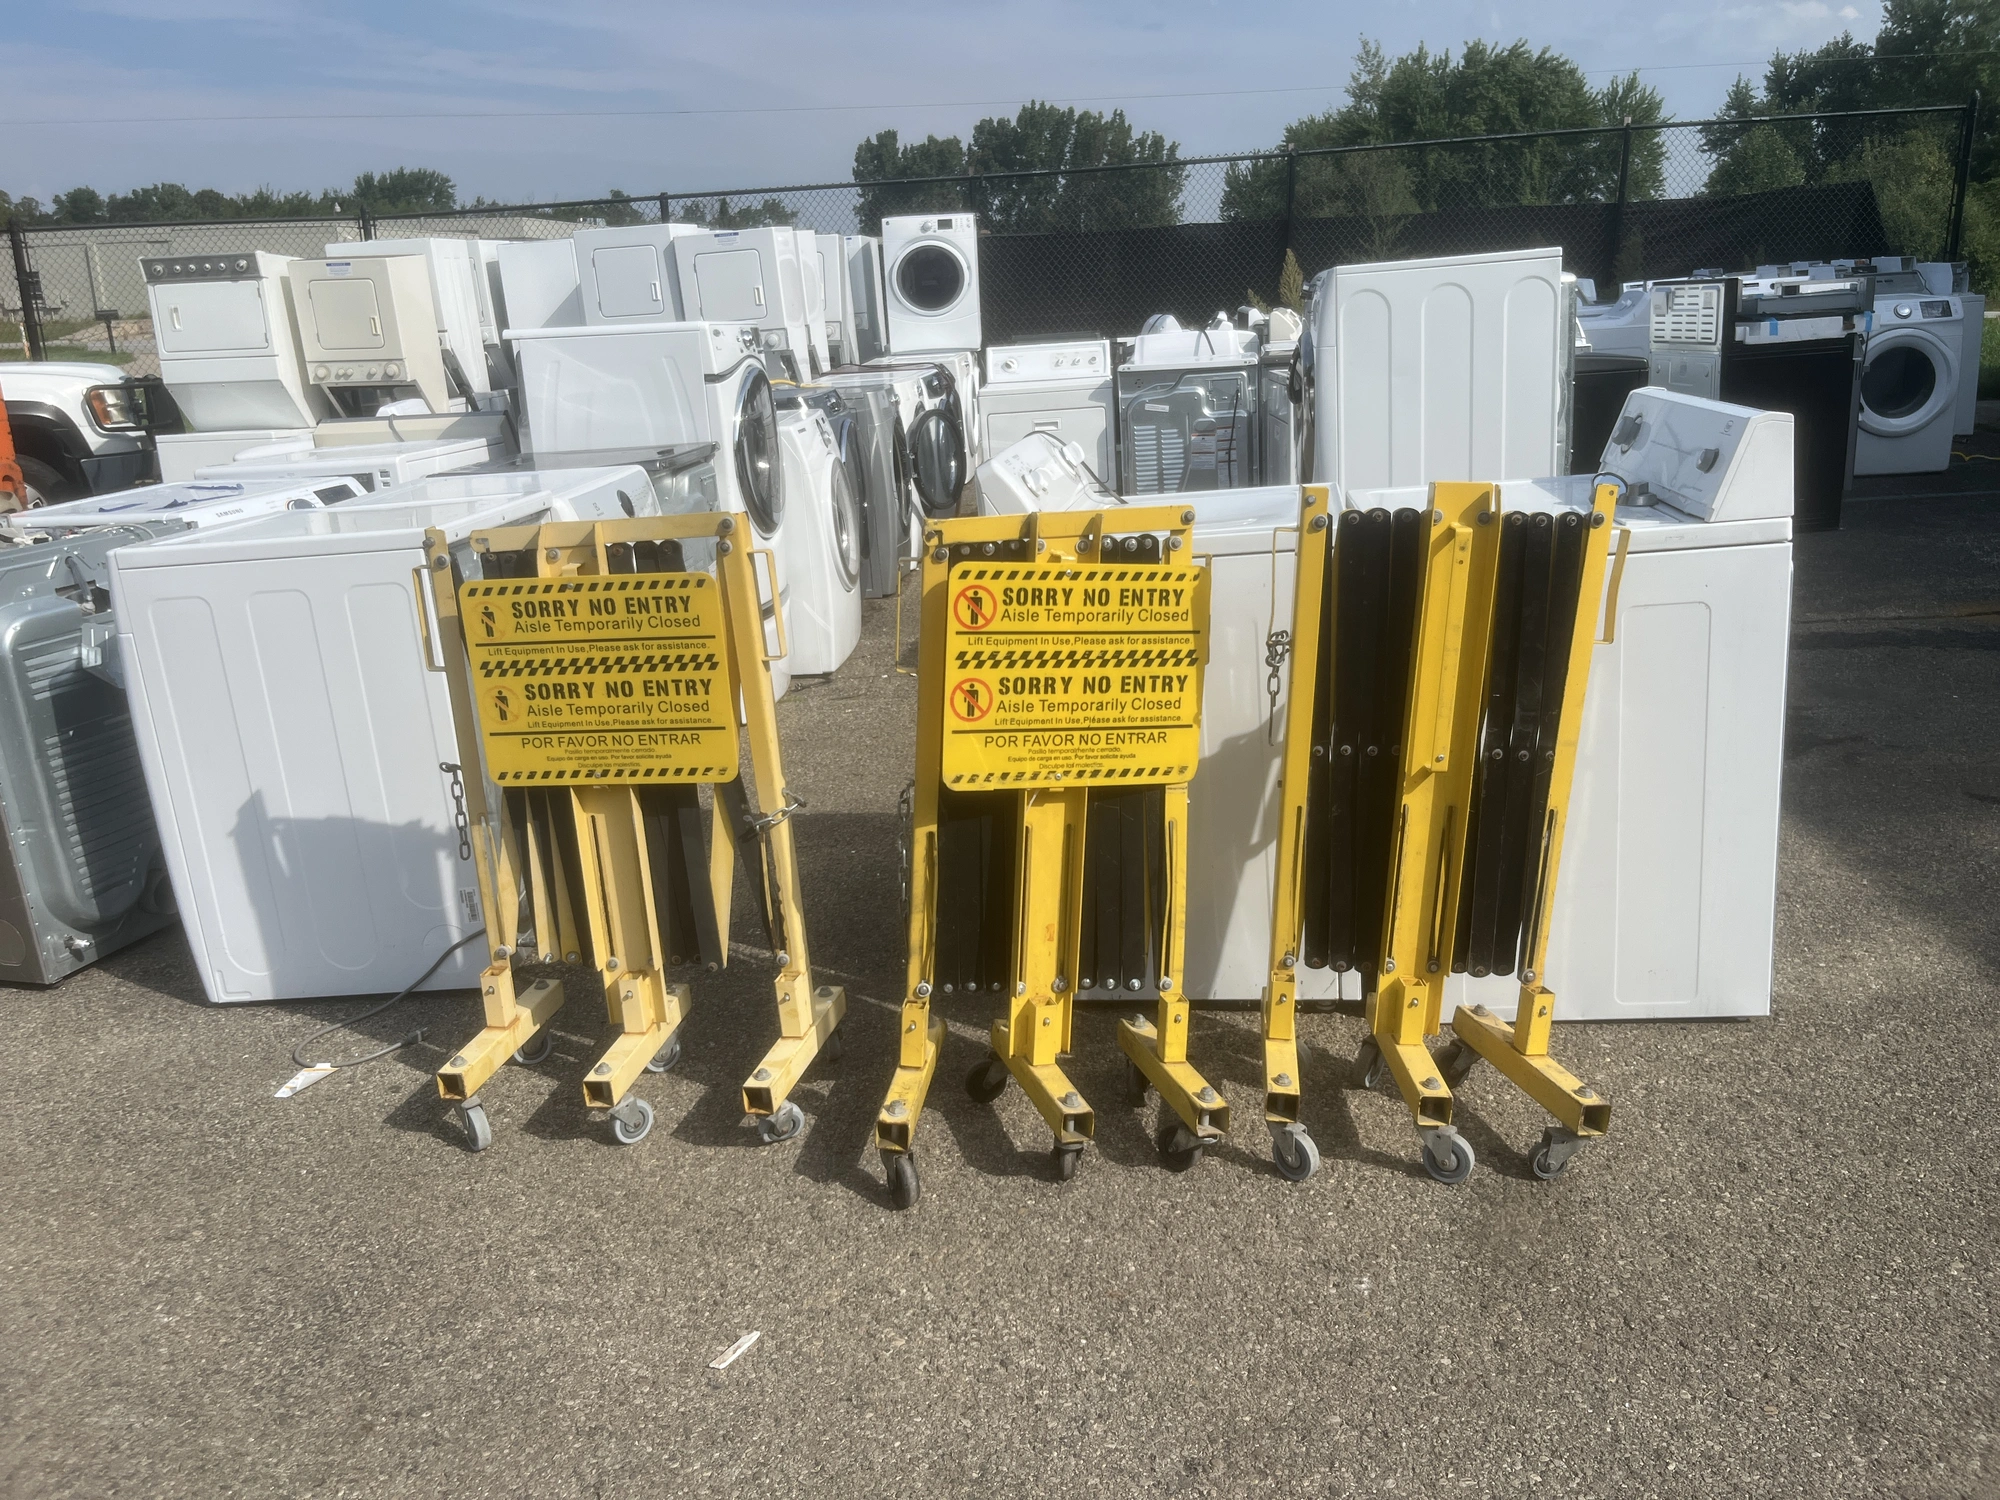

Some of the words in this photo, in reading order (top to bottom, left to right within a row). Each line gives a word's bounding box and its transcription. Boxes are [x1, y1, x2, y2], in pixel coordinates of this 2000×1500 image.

[215, 508, 244, 518] SAMSUNG
[1002, 587, 1074, 607] SORRY
[1083, 588, 1111, 607] NO
[1119, 588, 1184, 607] ENTRY
[512, 599, 579, 619] SORRY
[590, 598, 616, 616] NO
[625, 595, 691, 615] ENTRY
[514, 620, 551, 633] Aisle
[555, 616, 643, 633] Temporarily
[648, 614, 700, 628] Closed
[1001, 608, 1039, 622] Aisle
[1044, 608, 1133, 625] Temporarily
[1138, 609, 1189, 622] Closed
[968, 636, 983, 645] Lift
[986, 636, 1038, 647] Equipment
[1040, 637, 1049, 645] In
[1108, 636, 1125, 645] ask
[1127, 636, 1139, 645] for
[488, 647, 503, 656] Lift
[505, 646, 554, 657] Equipment
[557, 646, 566, 654] In
[524, 681, 595, 700] SORRY
[605, 680, 634, 698] NO
[643, 678, 712, 697] ENTRY
[998, 676, 1073, 695] SORRY
[1082, 676, 1110, 694] NO
[1120, 675, 1188, 694] ENTRY
[527, 705, 563, 717] Aisle
[566, 701, 654, 717] Temporarily
[658, 700, 710, 713] Closed
[996, 700, 1034, 713] Aisle
[1039, 698, 1127, 714] Temporarily
[1131, 697, 1181, 710] Closed
[528, 720, 541, 729] Lift
[542, 720, 584, 729] Equipment
[995, 718, 1009, 726] Lift
[1010, 717, 1053, 727] Equipment
[1128, 715, 1138, 723] for
[521, 737, 554, 749] POR
[557, 735, 609, 748] FAVOR
[612, 734, 634, 746] NO
[638, 733, 701, 746] ENTRAR
[985, 735, 1018, 748] POR
[1023, 734, 1075, 747] FAVOR
[1079, 733, 1101, 746] NO
[1105, 732, 1167, 745] ENTRAR
